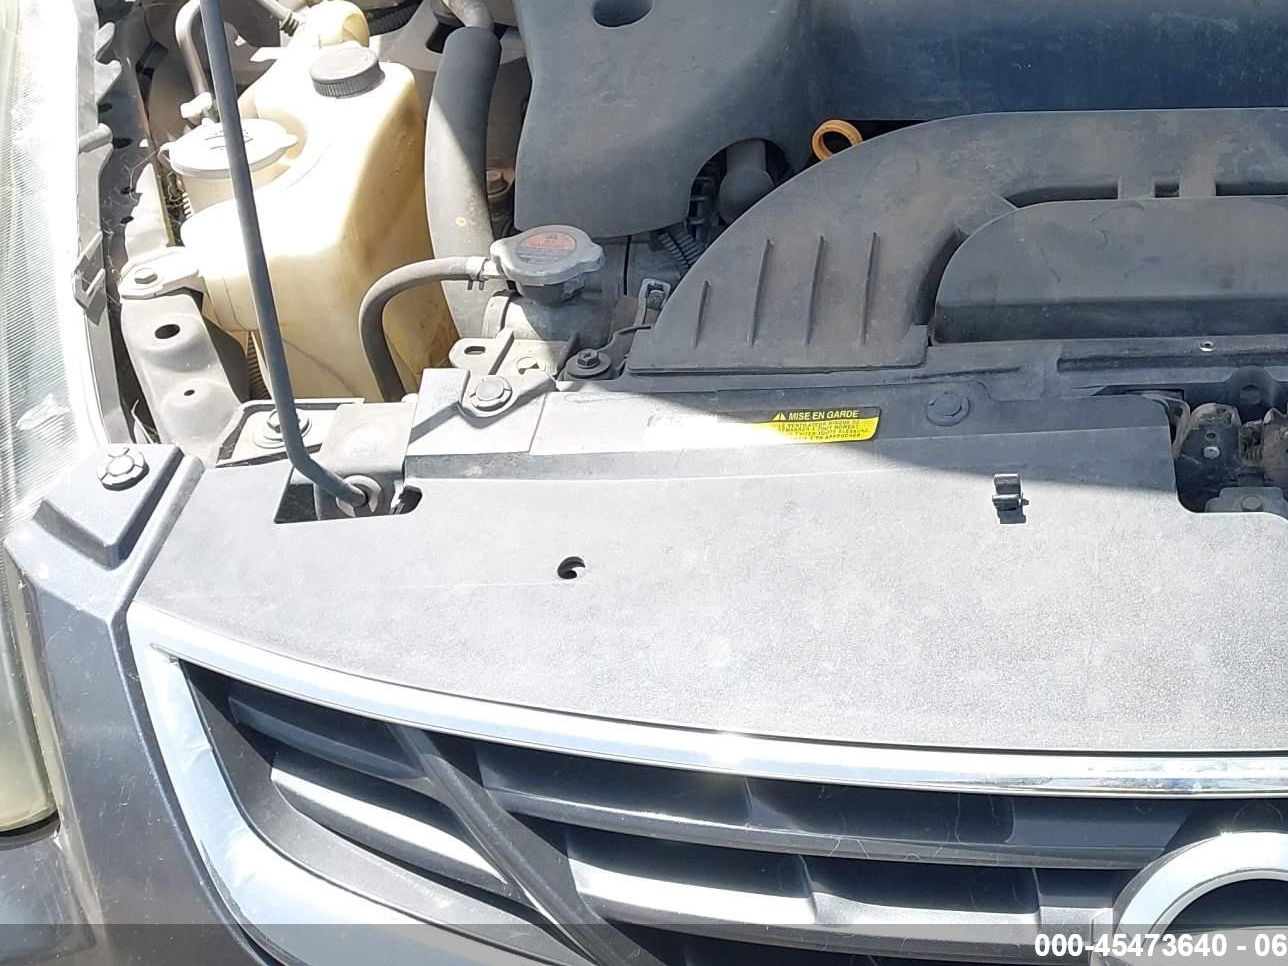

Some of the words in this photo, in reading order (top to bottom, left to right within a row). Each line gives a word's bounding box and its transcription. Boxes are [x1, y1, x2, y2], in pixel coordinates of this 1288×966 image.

[788, 411, 810, 421] MISE
[812, 411, 825, 420] EN
[826, 409, 860, 419] GARDE
